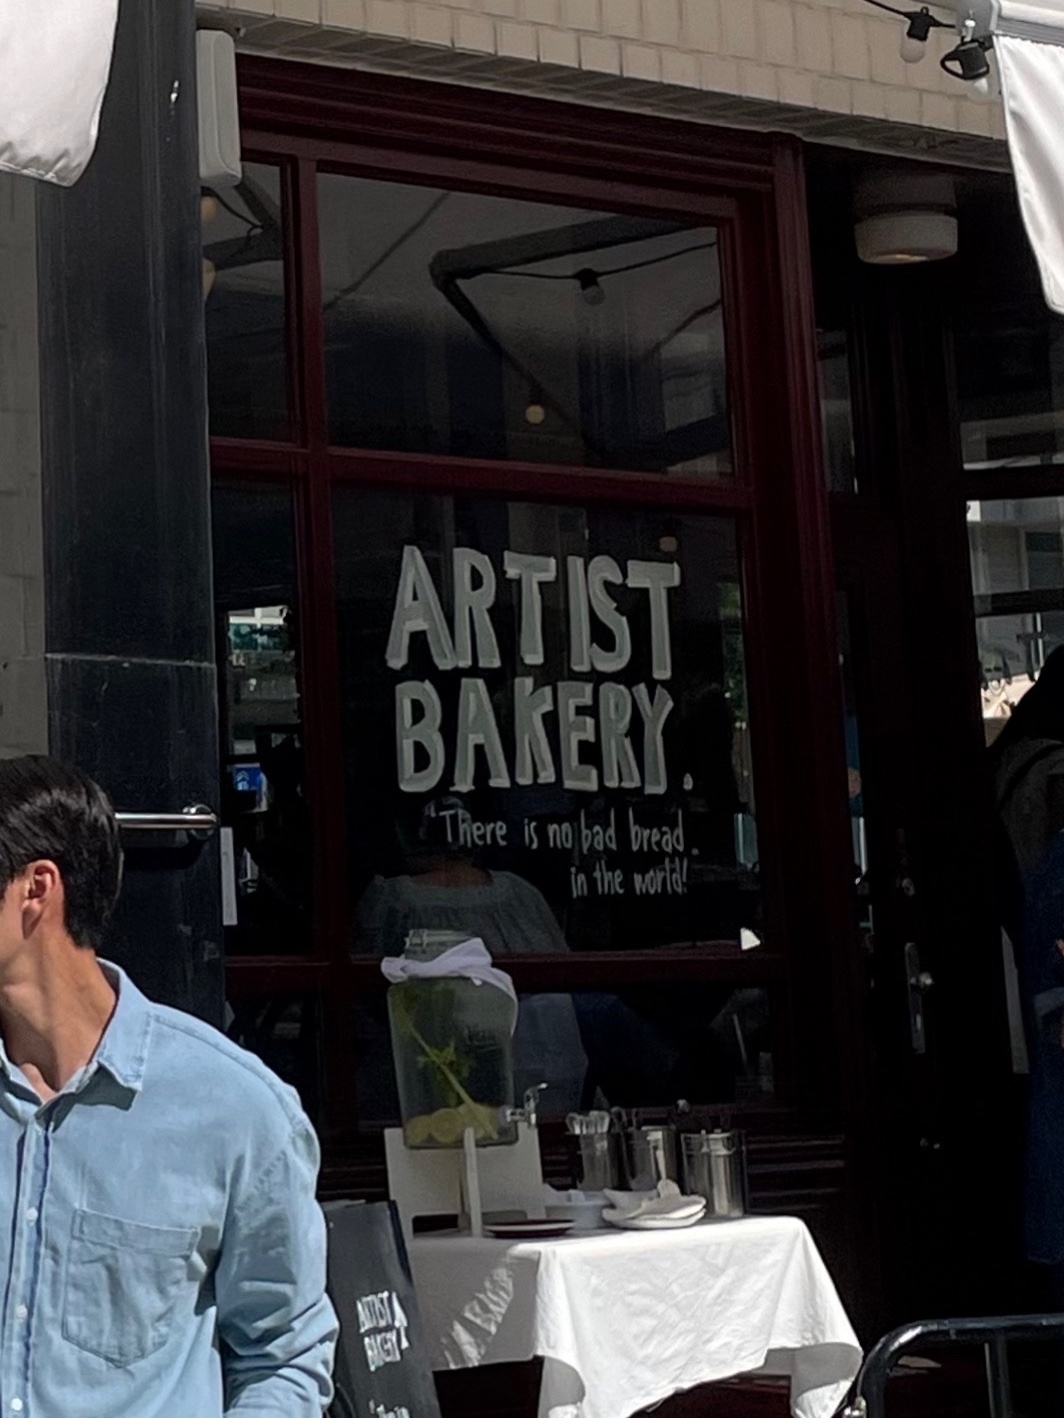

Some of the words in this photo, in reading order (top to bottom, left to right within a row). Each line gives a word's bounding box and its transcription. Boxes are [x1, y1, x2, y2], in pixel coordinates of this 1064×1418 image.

[385, 545, 681, 680] ARTIST
[395, 676, 693, 795] BAKERY.
[524, 818, 538, 850] is
[547, 822, 574, 849] no
[580, 808, 617, 853] bad
[570, 866, 589, 899] in
[592, 859, 625, 895] the
